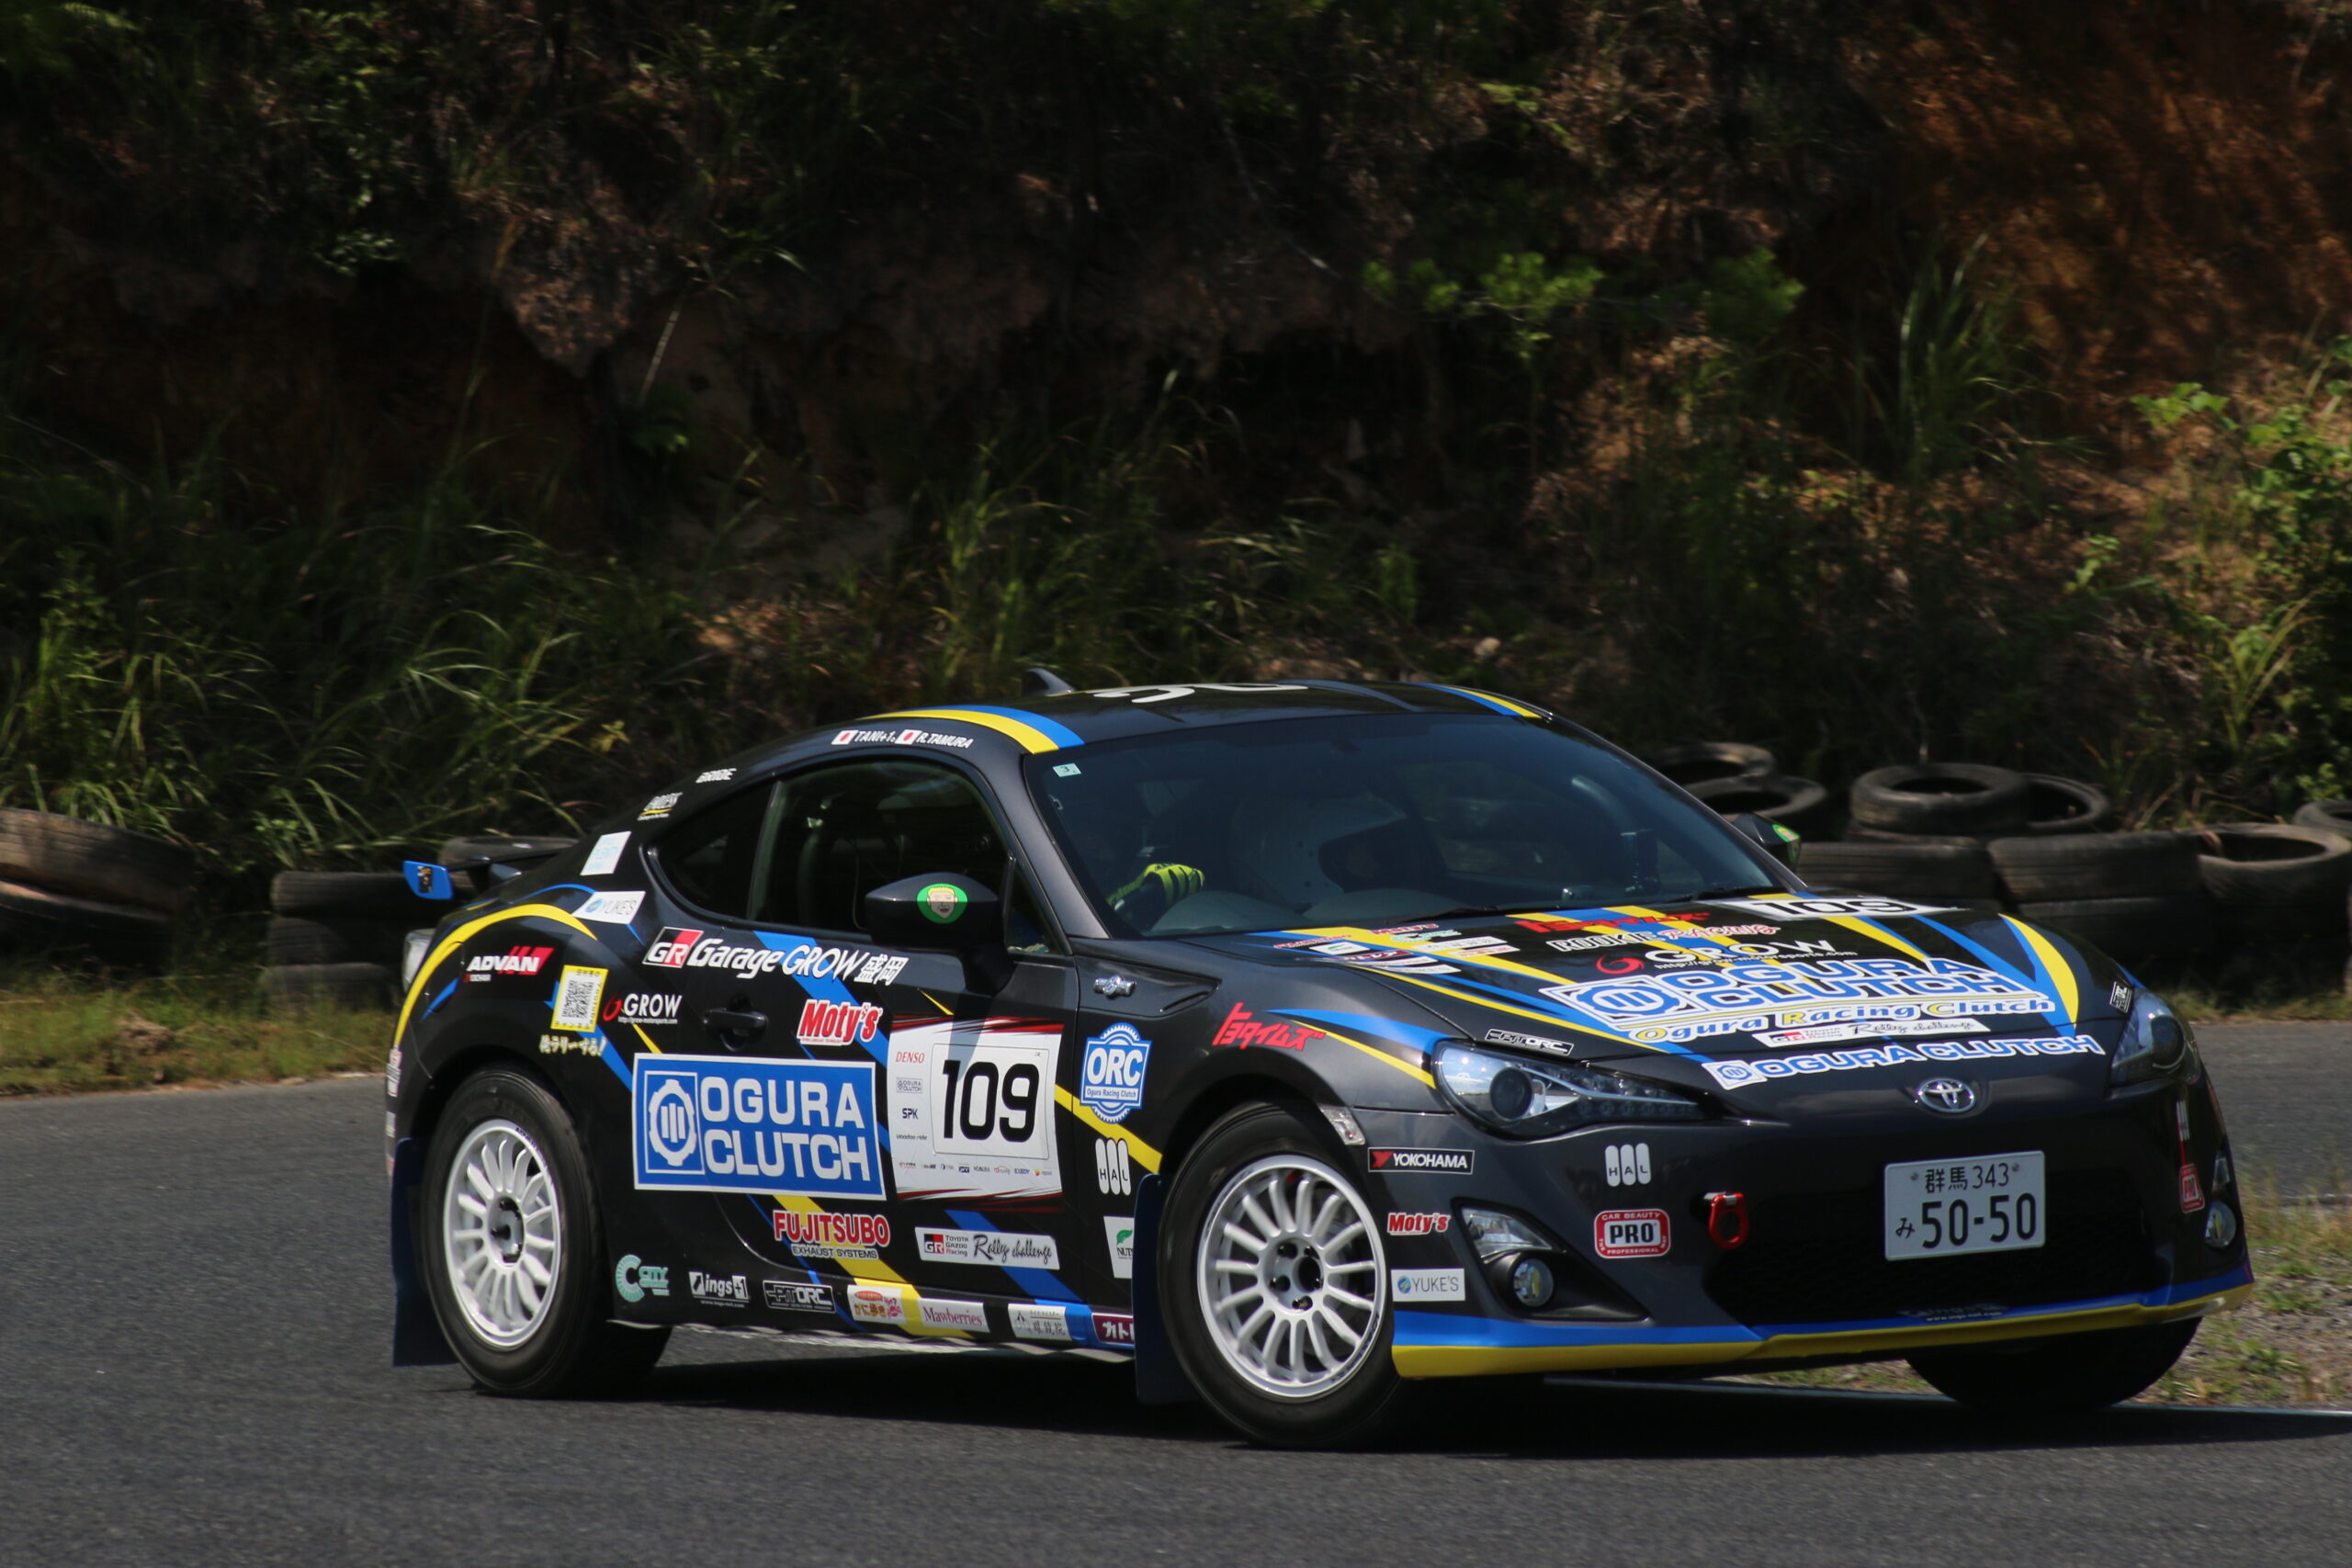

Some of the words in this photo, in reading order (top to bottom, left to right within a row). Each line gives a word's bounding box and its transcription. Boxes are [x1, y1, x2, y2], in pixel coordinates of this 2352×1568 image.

[917, 733, 974, 749] R.TAMURA
[1752, 899, 1921, 918] 109
[1546, 931, 1662, 952] ROOKIE
[1645, 940, 1837, 964] GROW
[466, 955, 540, 972] ADVAN
[647, 942, 689, 965] GR
[686, 938, 786, 979] Garage
[781, 944, 870, 981] GROW
[854, 953, 910, 986] 盛岡
[1660, 956, 1981, 989] OGURA
[1693, 976, 2026, 1009] CLUTCH
[624, 993, 682, 1018] GROW
[797, 999, 882, 1043] Moty's
[1634, 1017, 1763, 1042] Ogura
[1781, 1002, 1915, 1025] Racing
[1926, 999, 2050, 1017] Clutch
[896, 1051, 925, 1064] DENSO
[1087, 1047, 1143, 1087] ORC
[1757, 1047, 1914, 1077] OGURA
[1921, 1036, 2102, 1060] CLUTCH
[700, 1076, 865, 1129] OGURA
[942, 1059, 1040, 1143] 109
[1087, 1088, 1102, 1097] Ogura
[1102, 1089, 1119, 1099] Racing
[1121, 1089, 1136, 1098] Clutch
[901, 1107, 919, 1120] SPK
[704, 1129, 871, 1181] CLUTCH
[1393, 1153, 1468, 1168] YOKOHAMA
[1925, 1166, 1969, 1194] 群馬
[1971, 1162, 2010, 1189] 343
[773, 1210, 890, 1247] FUJITSUBO
[1388, 1213, 1450, 1235] Moty's
[1601, 1213, 1621, 1221] CAR
[1623, 1212, 1661, 1220] BEAUTY
[1894, 1217, 1917, 1240] み
[1921, 1192, 2037, 1249] 50-50
[1610, 1223, 1654, 1245] PRO
[791, 1245, 833, 1258] EXHAUST
[836, 1247, 878, 1259] SYSTEMS
[924, 1241, 944, 1255] GR
[973, 1234, 1010, 1263] Rally
[1412, 1276, 1459, 1292] YUKE'S
[922, 1306, 983, 1326] Mawberries
